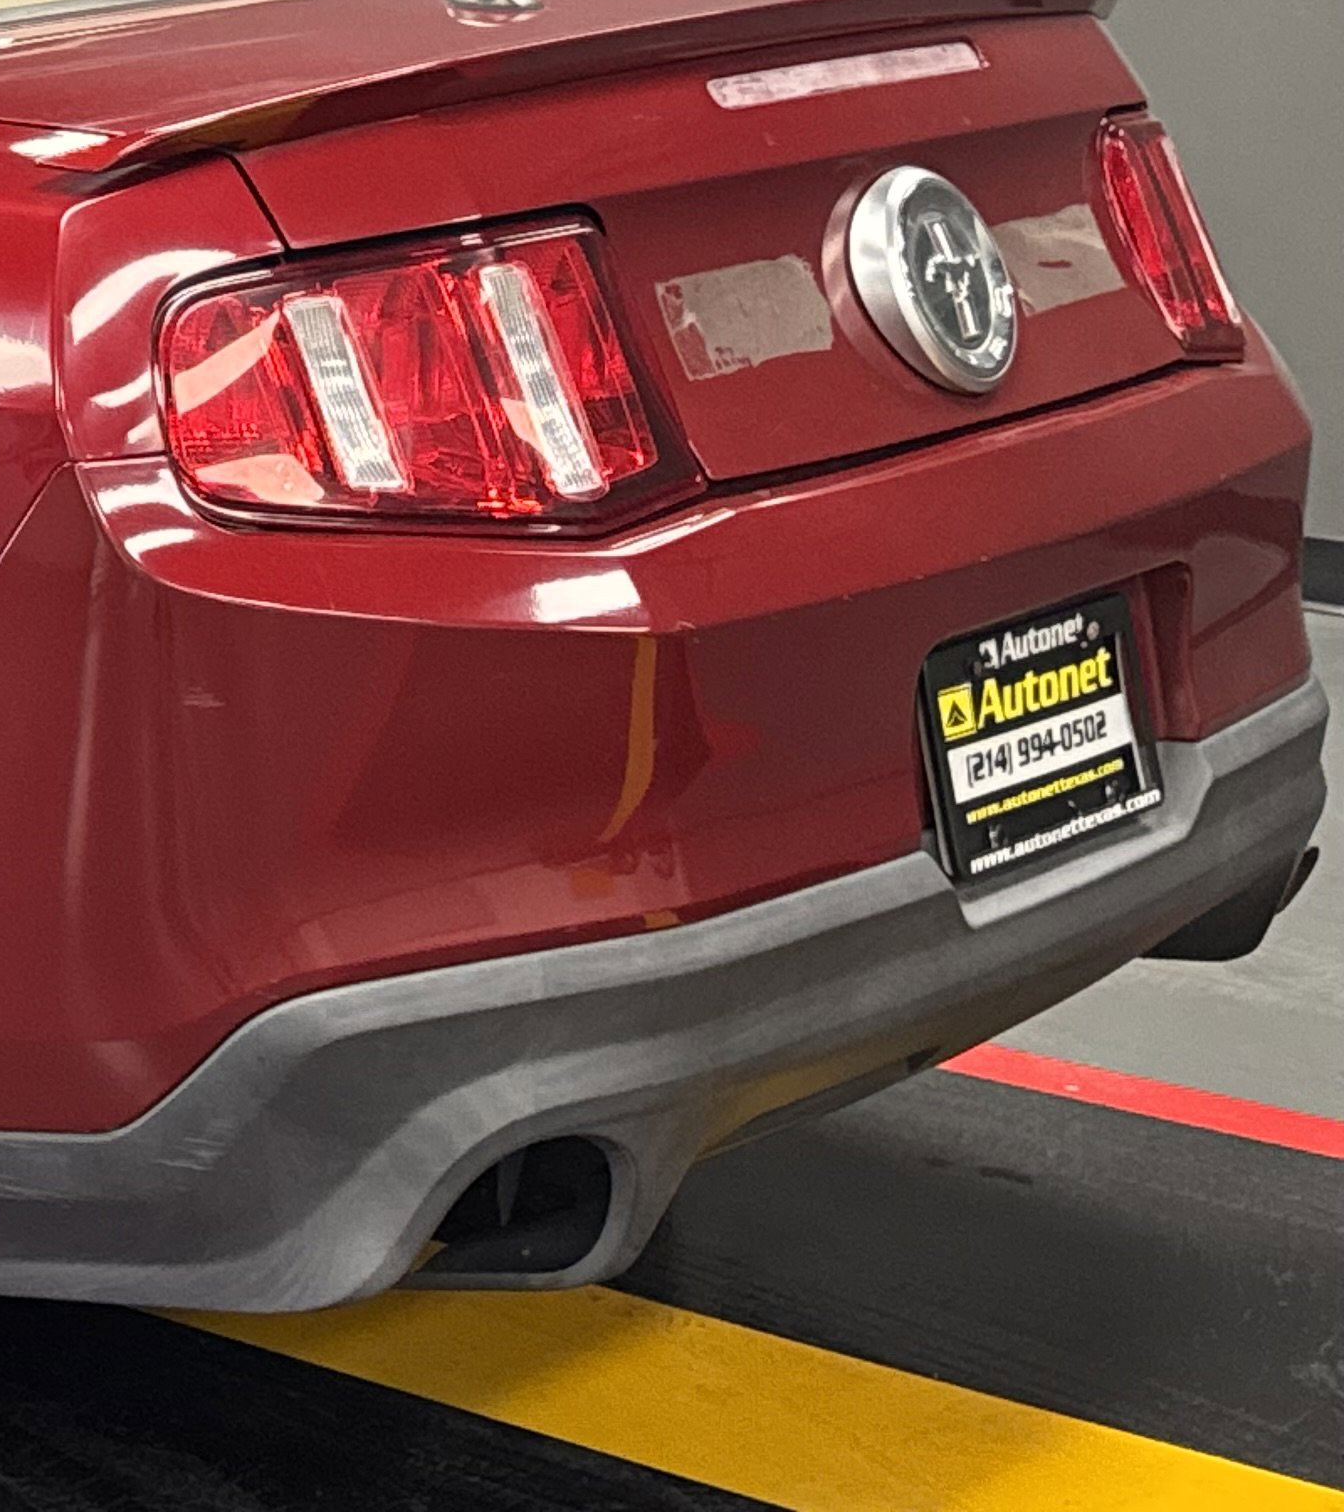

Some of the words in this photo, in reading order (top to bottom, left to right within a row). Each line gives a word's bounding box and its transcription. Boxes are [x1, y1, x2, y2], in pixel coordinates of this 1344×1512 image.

[1001, 612, 1083, 666] Autonet
[977, 646, 1112, 729] Autonet
[966, 741, 1014, 789] (214)
[1018, 710, 1108, 767] 994-0502
[970, 788, 1161, 875] www.autonettexas.com
